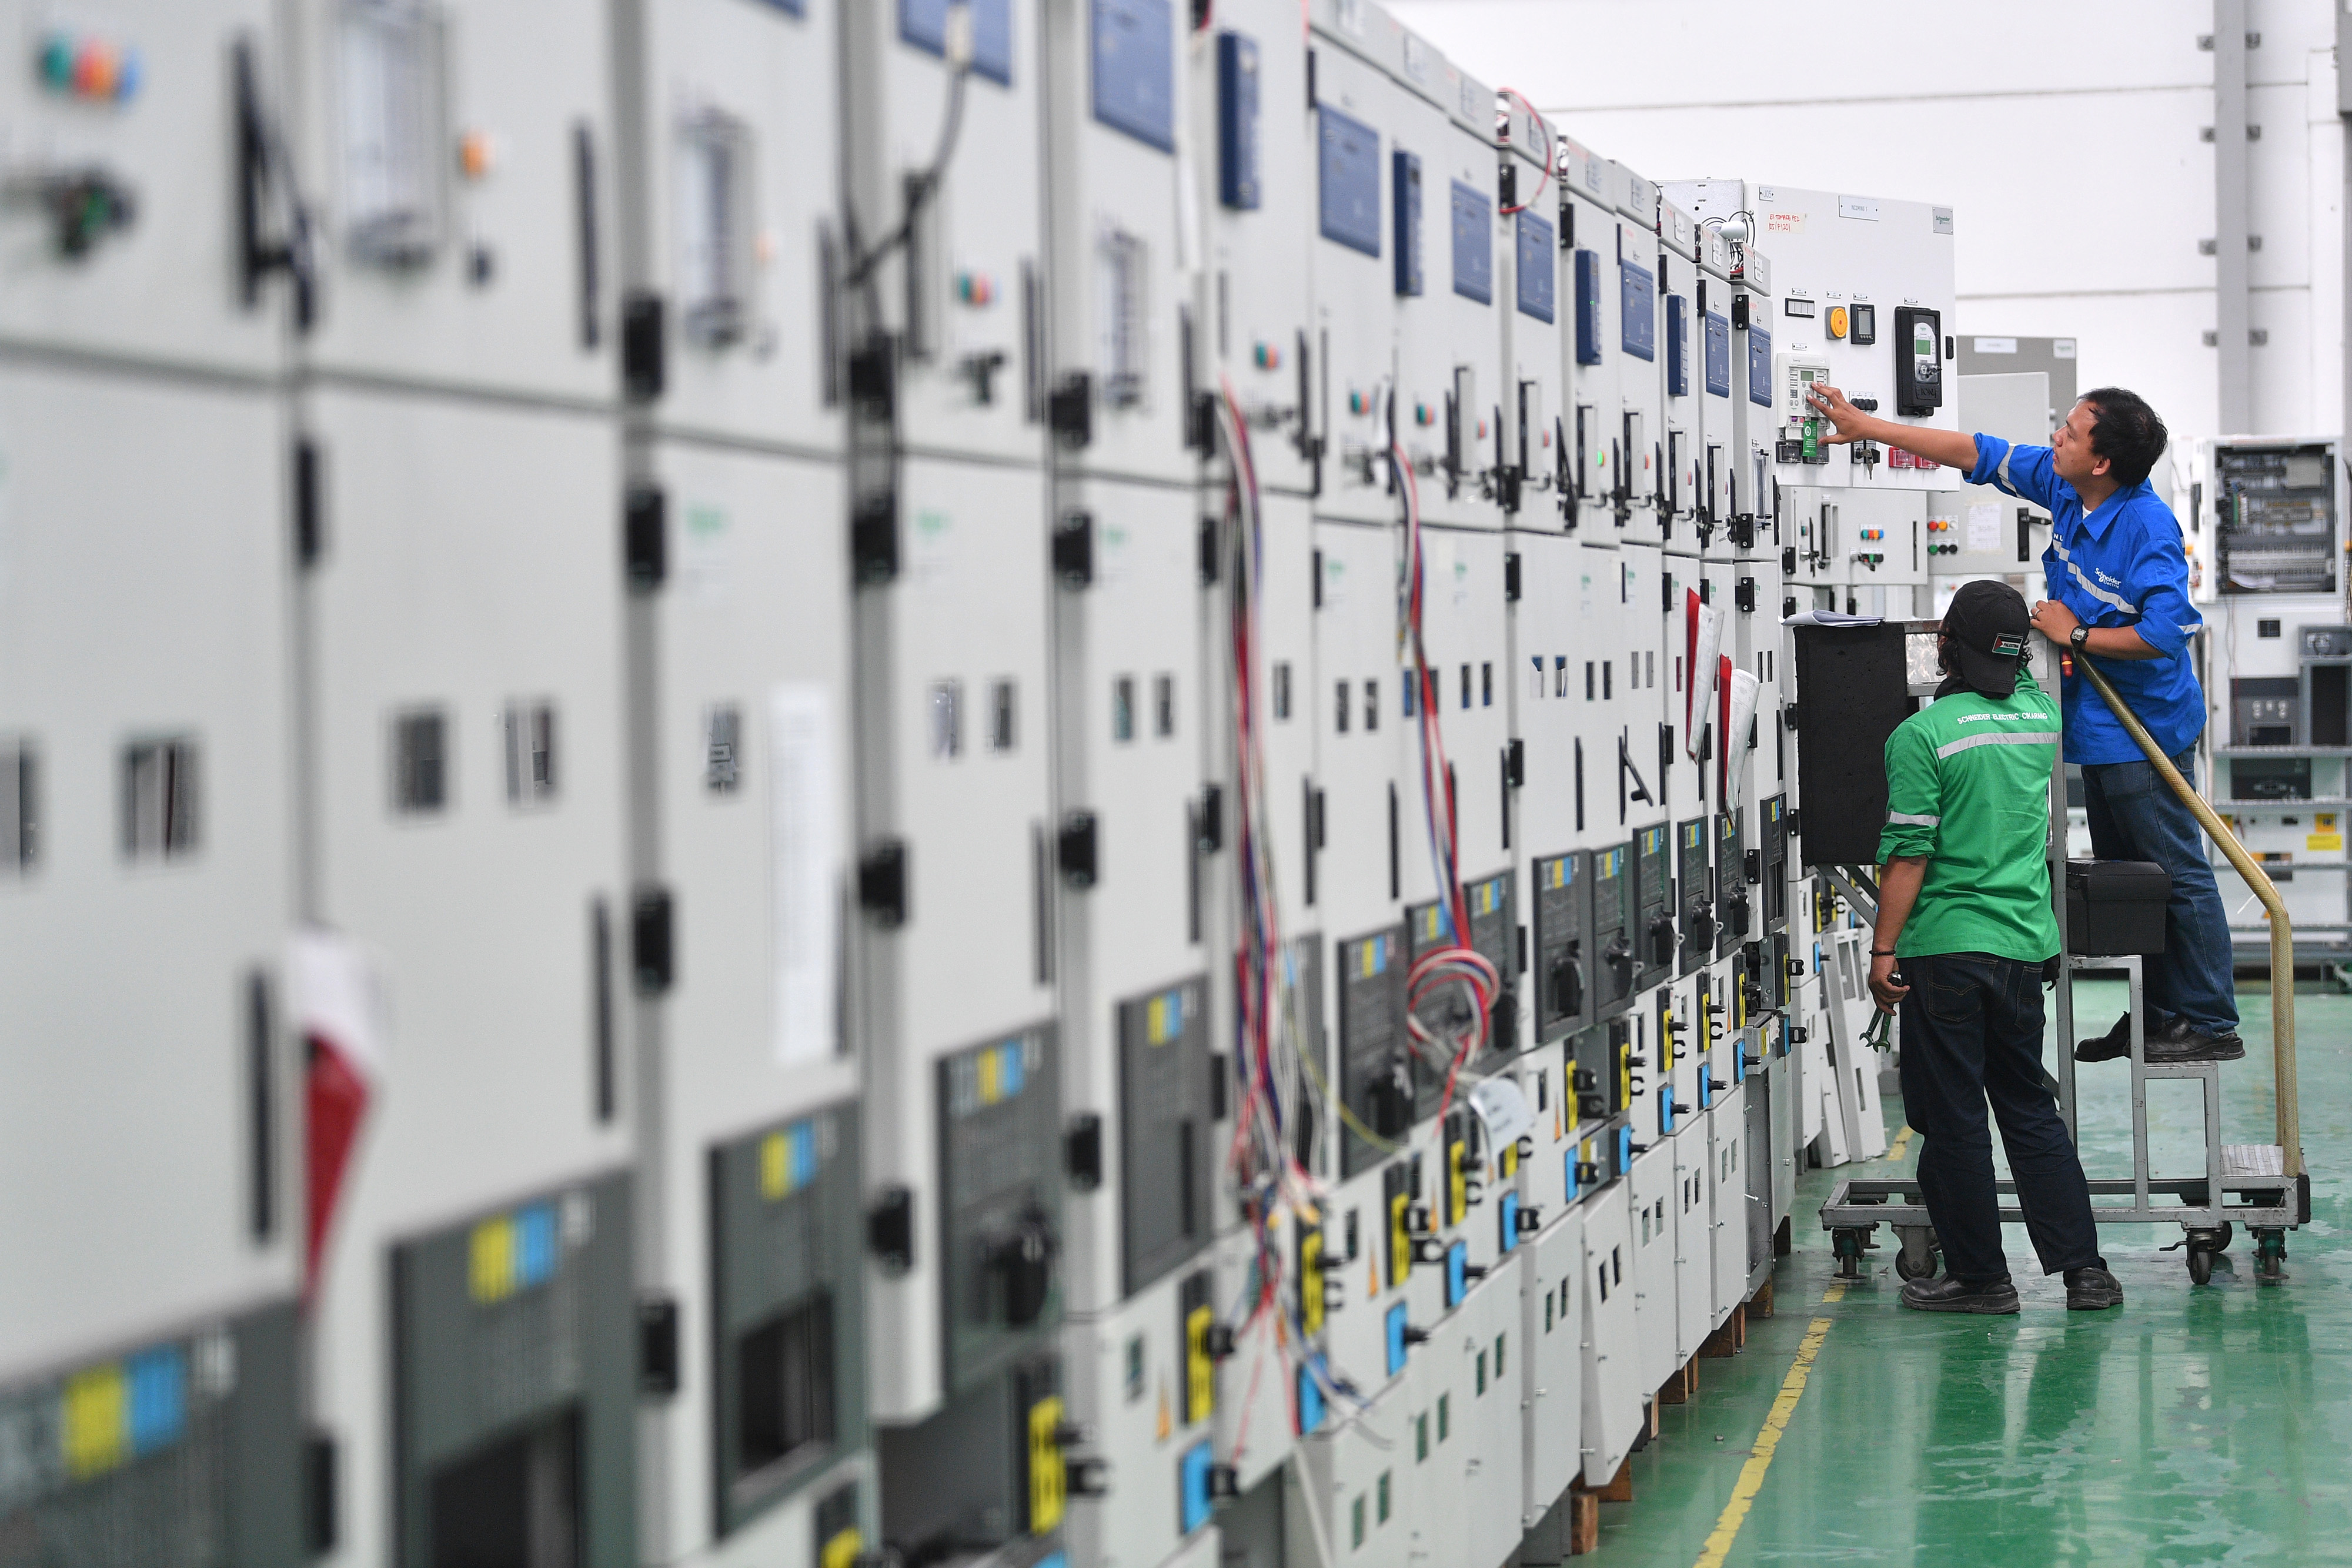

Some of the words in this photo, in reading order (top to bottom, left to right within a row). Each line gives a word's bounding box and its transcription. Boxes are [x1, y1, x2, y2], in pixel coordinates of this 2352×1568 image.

[2094, 567, 2122, 586] Schneider
[2103, 580, 2120, 589] Electric
[1957, 713, 1990, 724] SCHNEIDER
[1992, 713, 2019, 721] ELECTRIC
